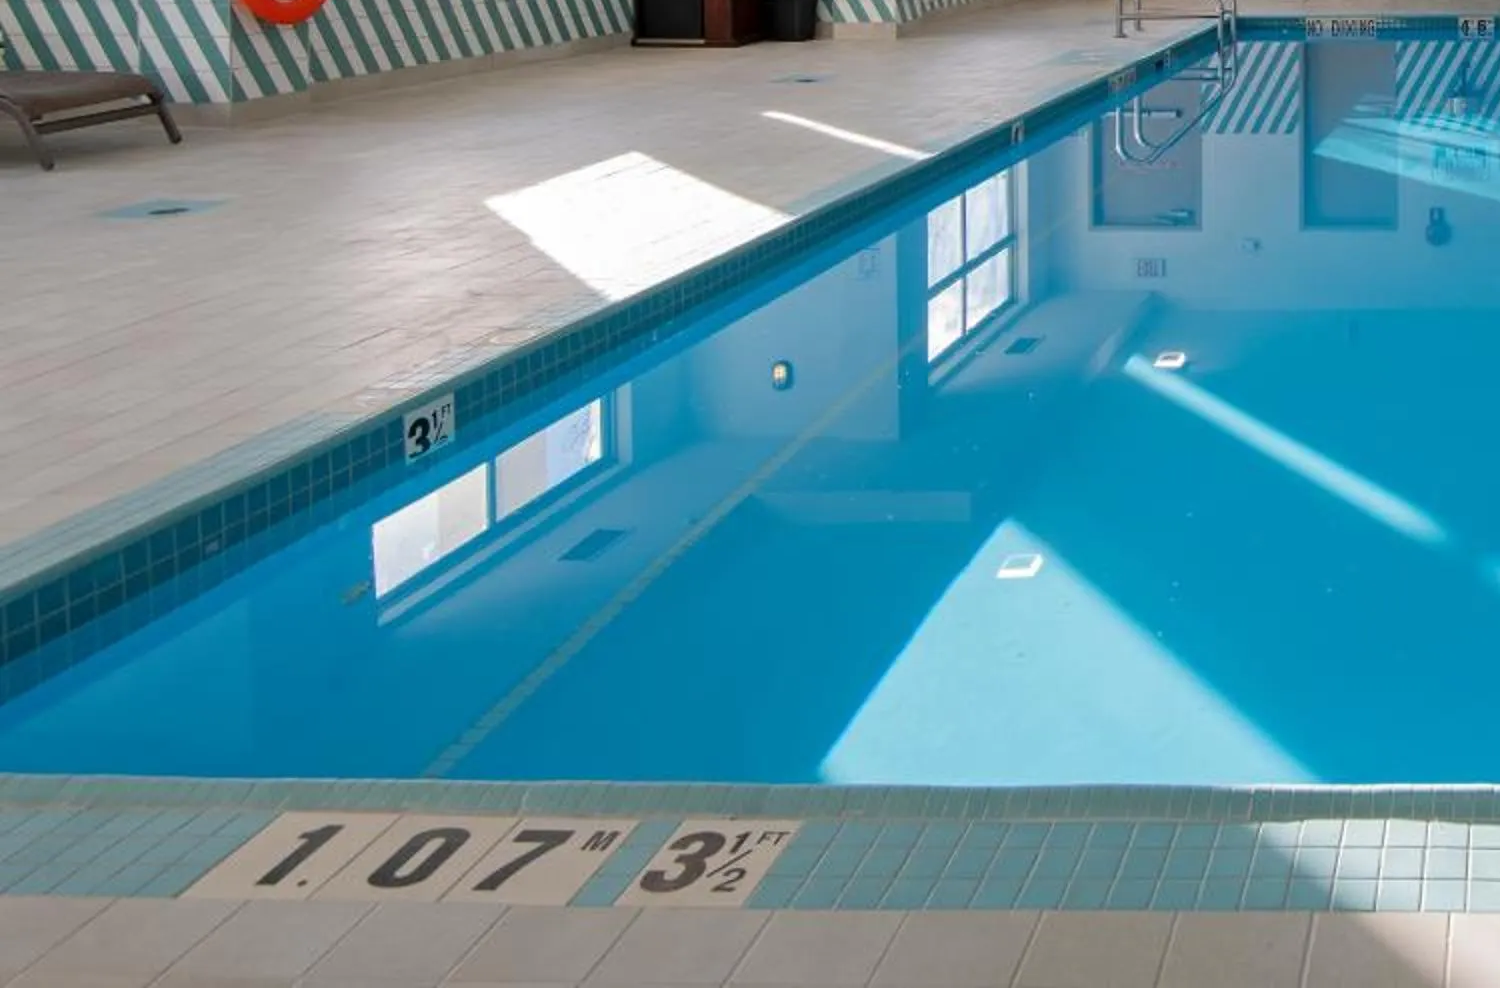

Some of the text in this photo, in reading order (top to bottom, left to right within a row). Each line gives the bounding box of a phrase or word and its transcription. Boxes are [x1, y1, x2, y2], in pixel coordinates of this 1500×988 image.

[1307, 19, 1375, 37] NO DIVING
[580, 830, 622, 852] M
[755, 830, 791, 846] FT
